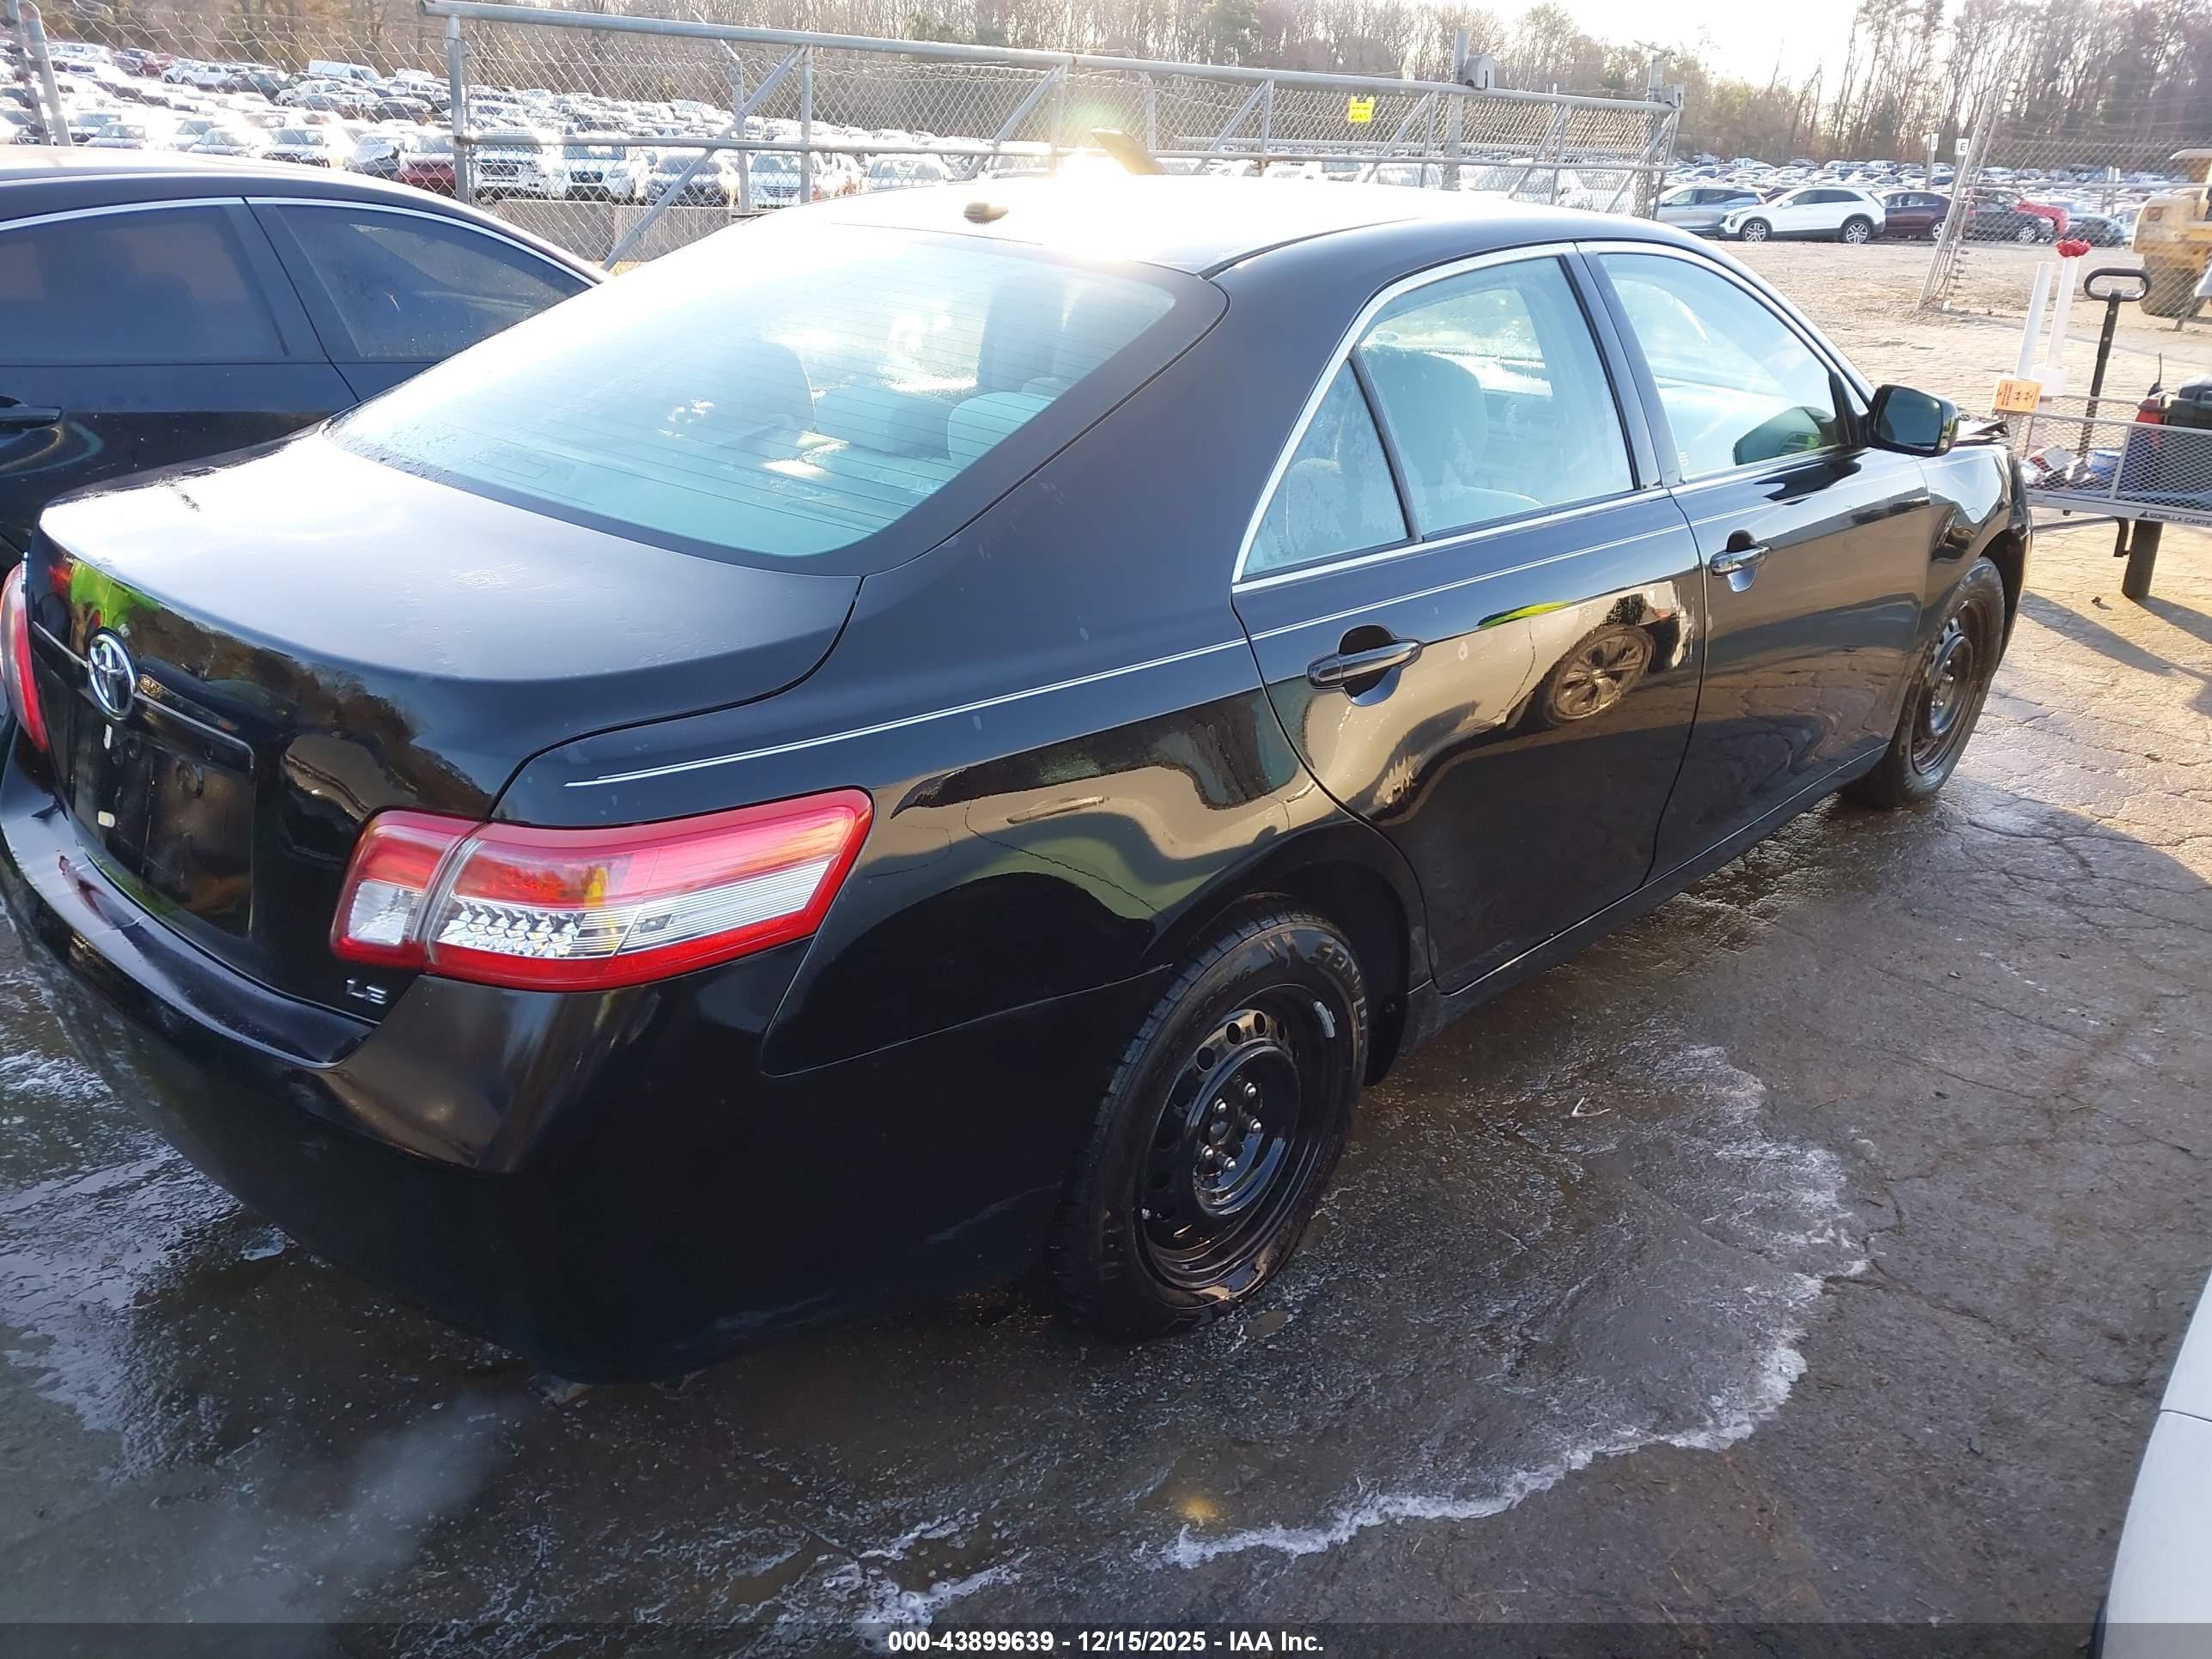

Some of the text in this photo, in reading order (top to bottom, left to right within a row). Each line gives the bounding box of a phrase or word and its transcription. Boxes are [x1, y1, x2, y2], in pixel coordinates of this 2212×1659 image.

[1960, 143, 1967, 151] E
[2149, 513, 2182, 523] GORILLA
[346, 979, 387, 1005] LE
